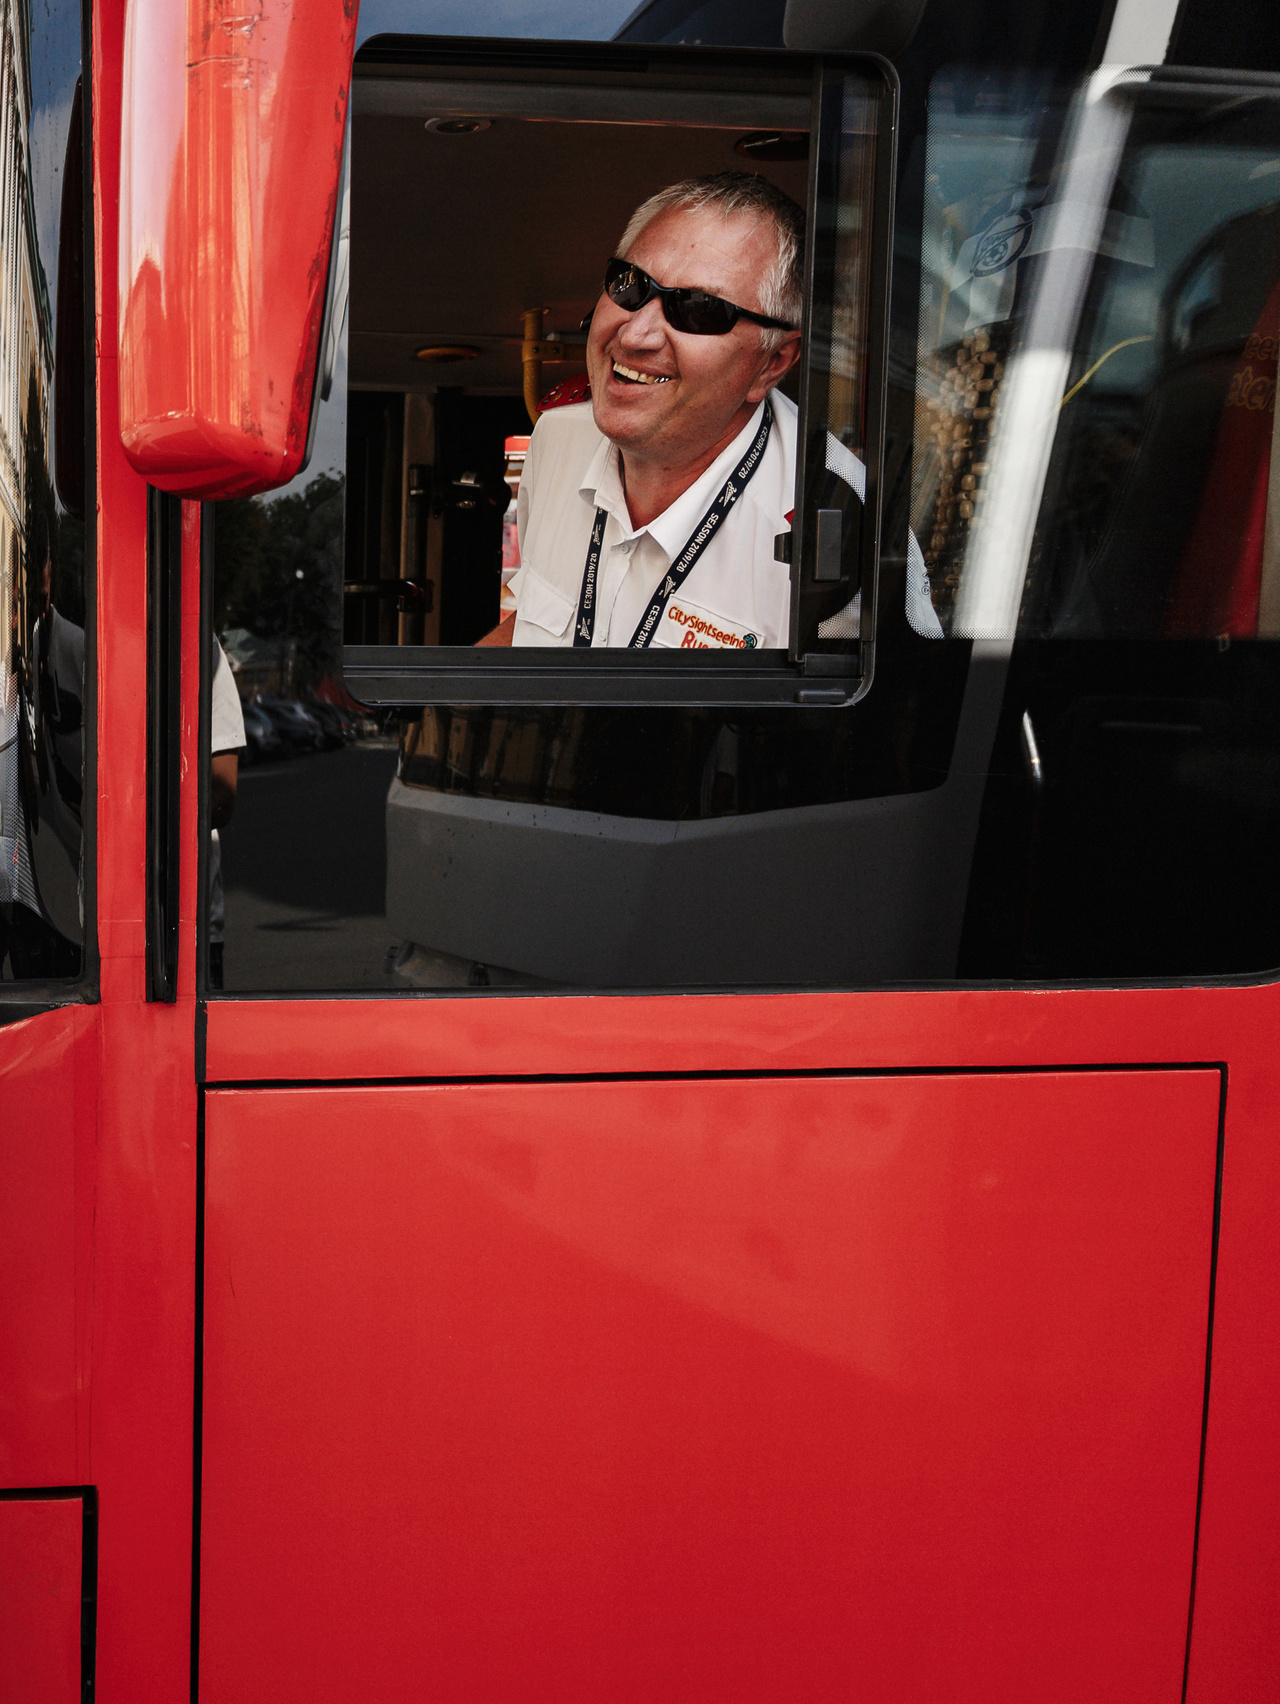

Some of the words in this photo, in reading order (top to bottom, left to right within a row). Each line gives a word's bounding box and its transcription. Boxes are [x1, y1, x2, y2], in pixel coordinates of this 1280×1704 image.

[737, 449, 760, 479] 2019/20
[698, 512, 719, 544] SEASON
[586, 552, 598, 583] 2019/20
[676, 542, 700, 573] 2019/20
[583, 583, 594, 609] СЕЗОН
[642, 605, 660, 631] СЕЗОН
